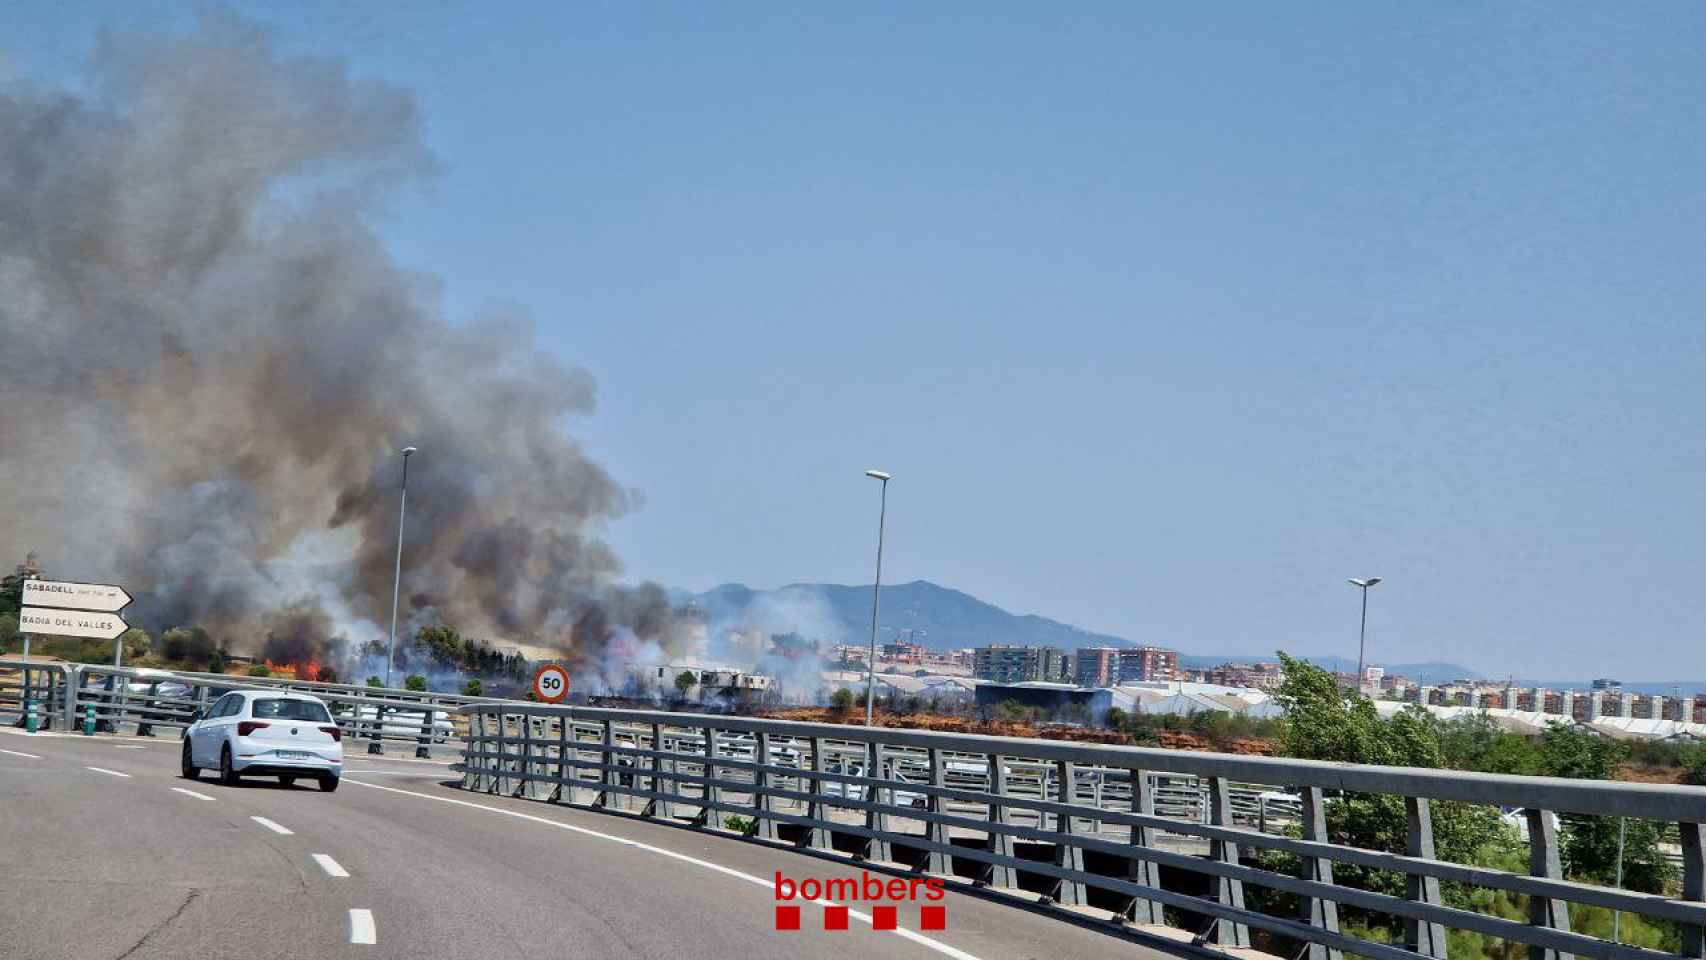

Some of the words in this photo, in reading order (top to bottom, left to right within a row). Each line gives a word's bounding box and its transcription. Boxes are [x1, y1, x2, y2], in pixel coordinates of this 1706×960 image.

[25, 583, 73, 594] SABADELL
[22, 615, 50, 625] BADIA
[55, 618, 73, 627] DEL
[543, 677, 560, 690] 50
